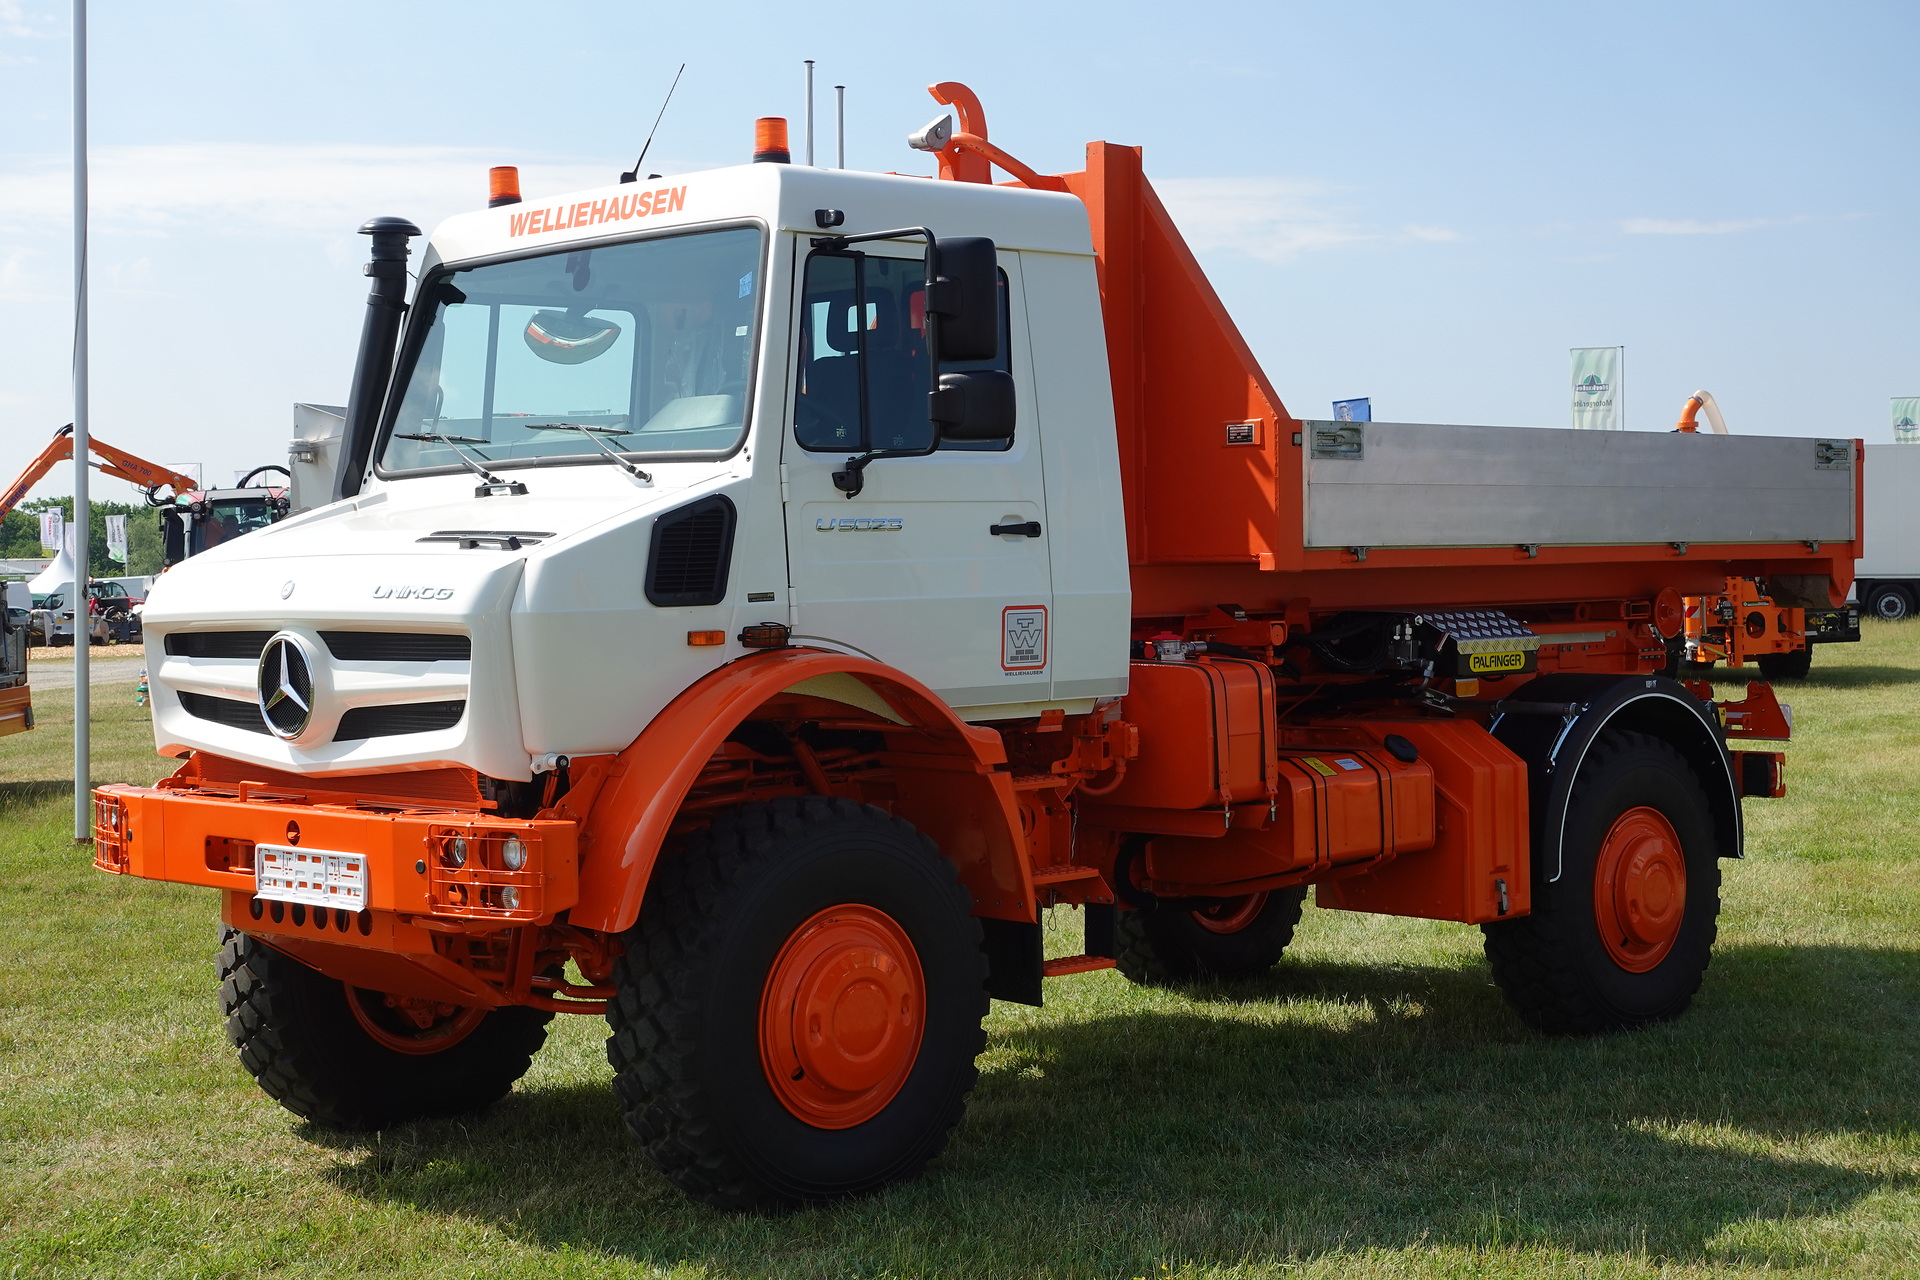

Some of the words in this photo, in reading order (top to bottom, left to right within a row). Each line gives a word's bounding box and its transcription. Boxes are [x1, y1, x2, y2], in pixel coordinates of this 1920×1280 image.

[510, 185, 687, 238] WELLIEHAUSEN
[121, 460, 138, 471] GHA
[139, 466, 152, 476] 700
[816, 518, 836, 532] U
[838, 518, 904, 532] 5023
[372, 585, 455, 601] UNIMOG
[1473, 653, 1522, 669] PALFINGER
